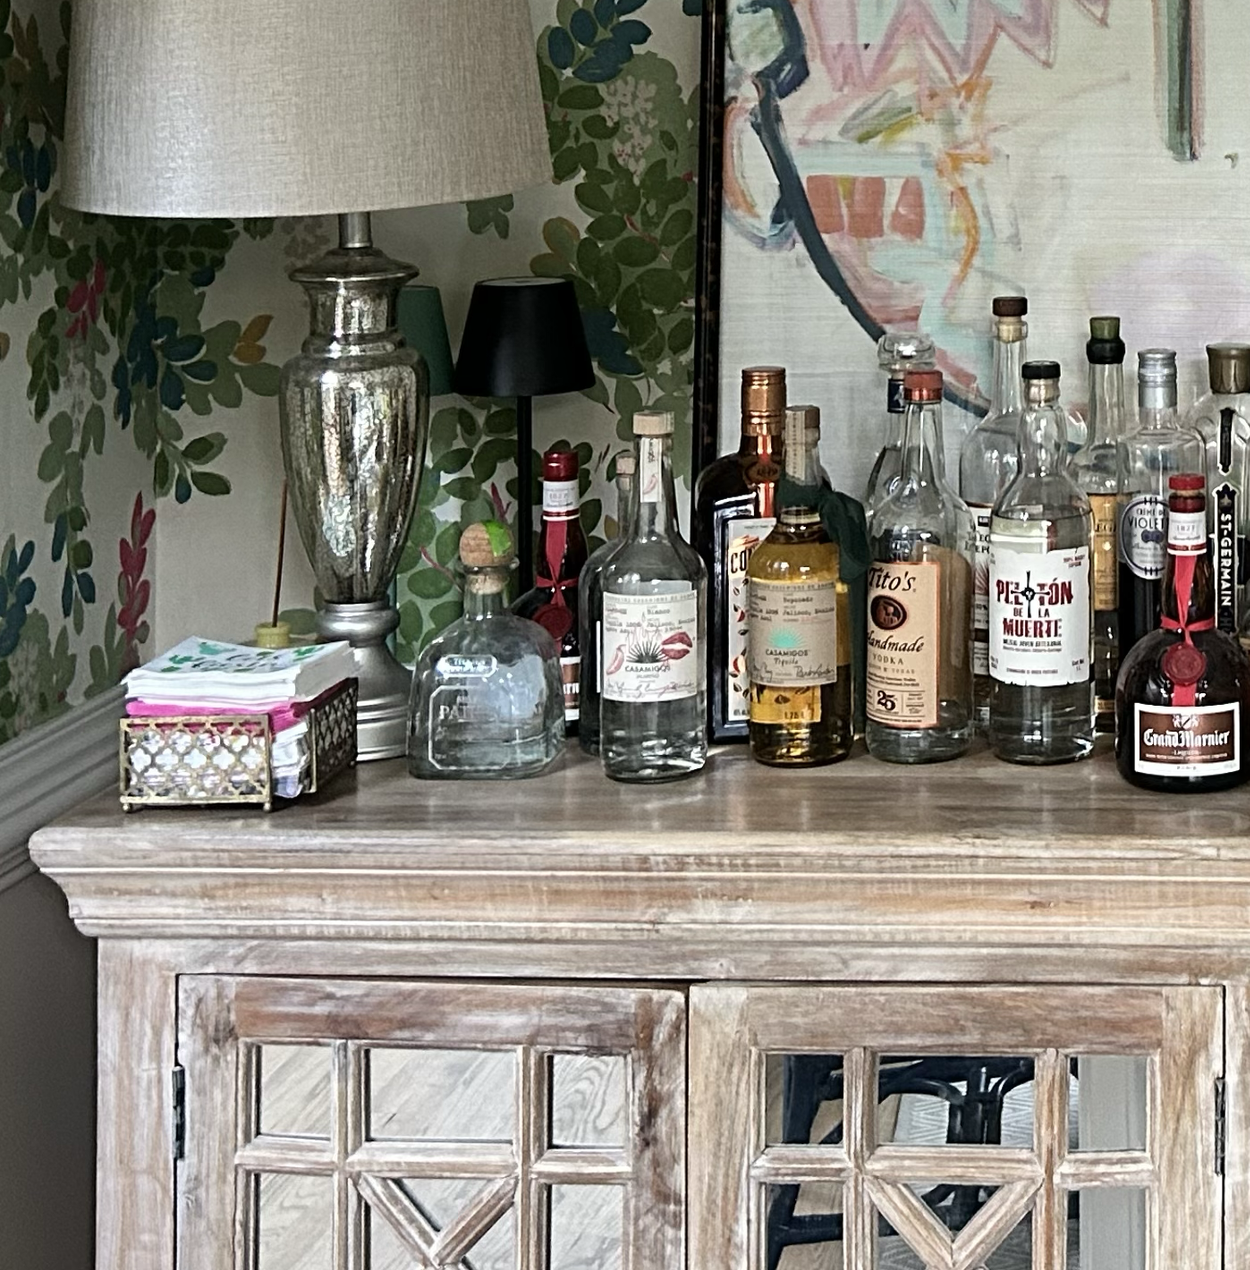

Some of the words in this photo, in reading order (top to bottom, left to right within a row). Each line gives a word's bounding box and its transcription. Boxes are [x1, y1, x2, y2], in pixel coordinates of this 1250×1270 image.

[1128, 516, 1167, 530] VIOLET
[1220, 513, 1232, 606] ST-GERMAIN
[868, 566, 916, 593] Tito's
[1013, 607, 1023, 618] DE
[1038, 607, 1050, 618] LA
[1003, 617, 1062, 638] MUERTE
[766, 649, 808, 657] CASAMIGOS
[873, 652, 904, 665] VODKA
[876, 690, 896, 711] 25
[1143, 728, 1179, 748] Grand
[1179, 729, 1230, 748] Marnier
